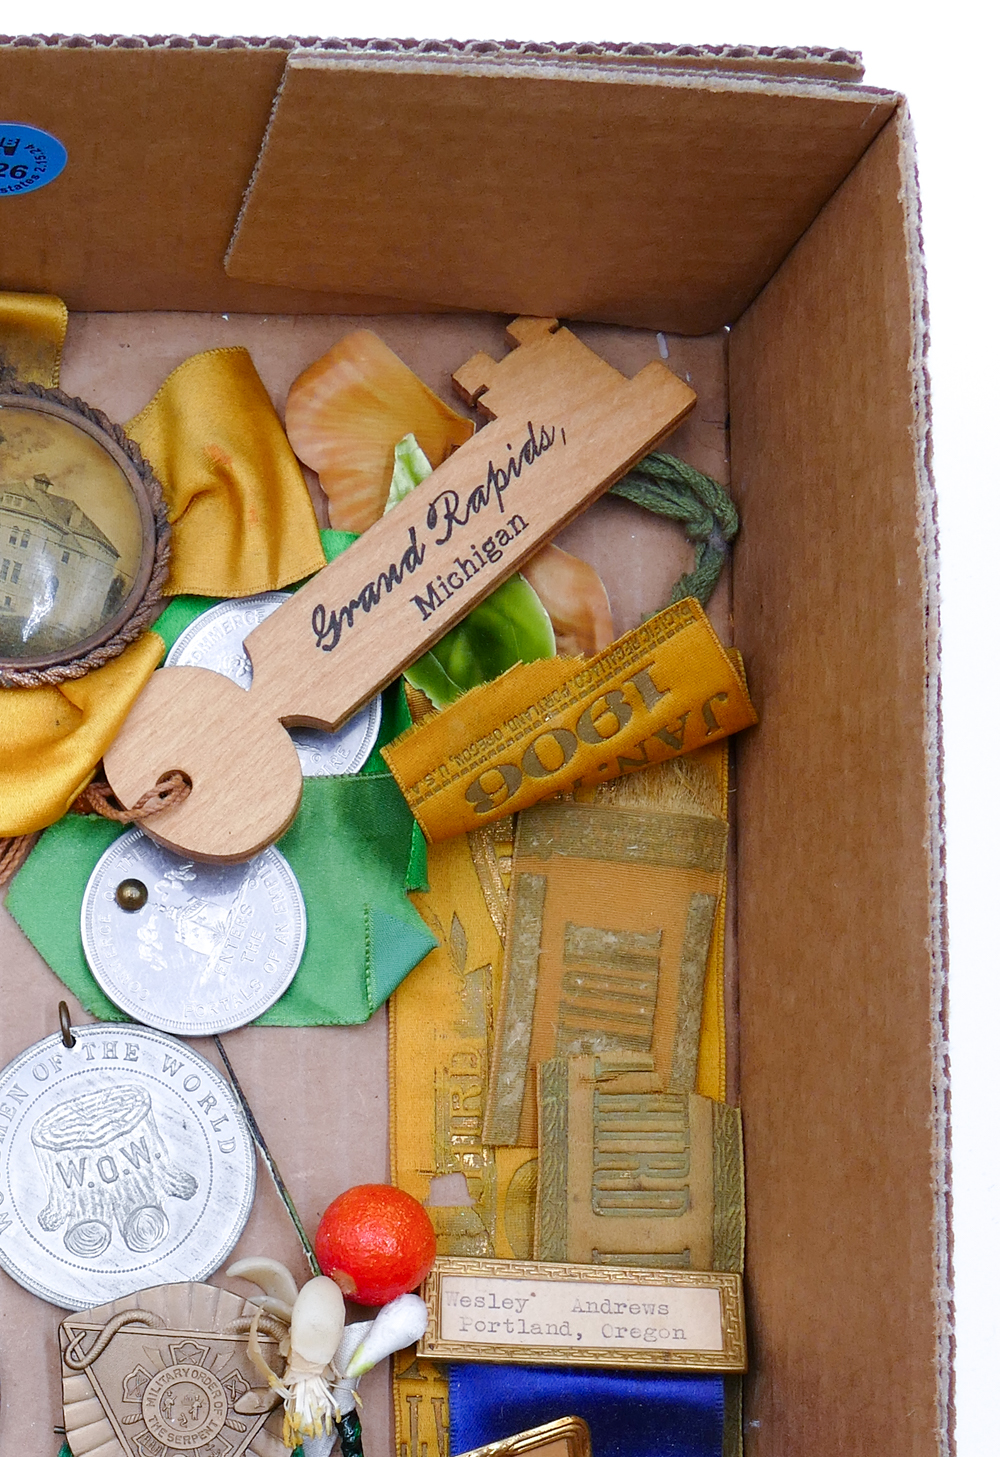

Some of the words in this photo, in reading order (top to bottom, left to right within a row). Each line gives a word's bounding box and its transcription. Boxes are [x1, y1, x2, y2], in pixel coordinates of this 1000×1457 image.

[310, 526, 428, 653] Grand
[427, 420, 568, 543] Rapids,
[410, 513, 528, 621] Michigan
[185, 609, 266, 666] OMMERCE
[447, 726, 505, 771] OREGON,
[463, 659, 673, 816] 1906
[115, 846, 147, 873] THE
[215, 903, 255, 976] ENTERS
[240, 930, 266, 965] THE
[183, 977, 265, 1018] PORTALS
[263, 950, 282, 974] OF
[274, 923, 290, 946] AN
[32, 1054, 64, 1081] OF
[82, 1040, 141, 1062] THE
[161, 1054, 237, 1154] WORLD
[55, 1136, 162, 1190] W.O.W.
[443, 1290, 529, 1313] Wesley
[571, 1298, 670, 1315] Andrews
[458, 1316, 584, 1340] Portland,
[601, 1323, 686, 1342] Oregon
[146, 1367, 190, 1408] MILITARY
[191, 1369, 221, 1402] ORDER
[214, 1401, 224, 1419] OF
[149, 1414, 167, 1439] THE
[167, 1420, 219, 1445] SERPENT
